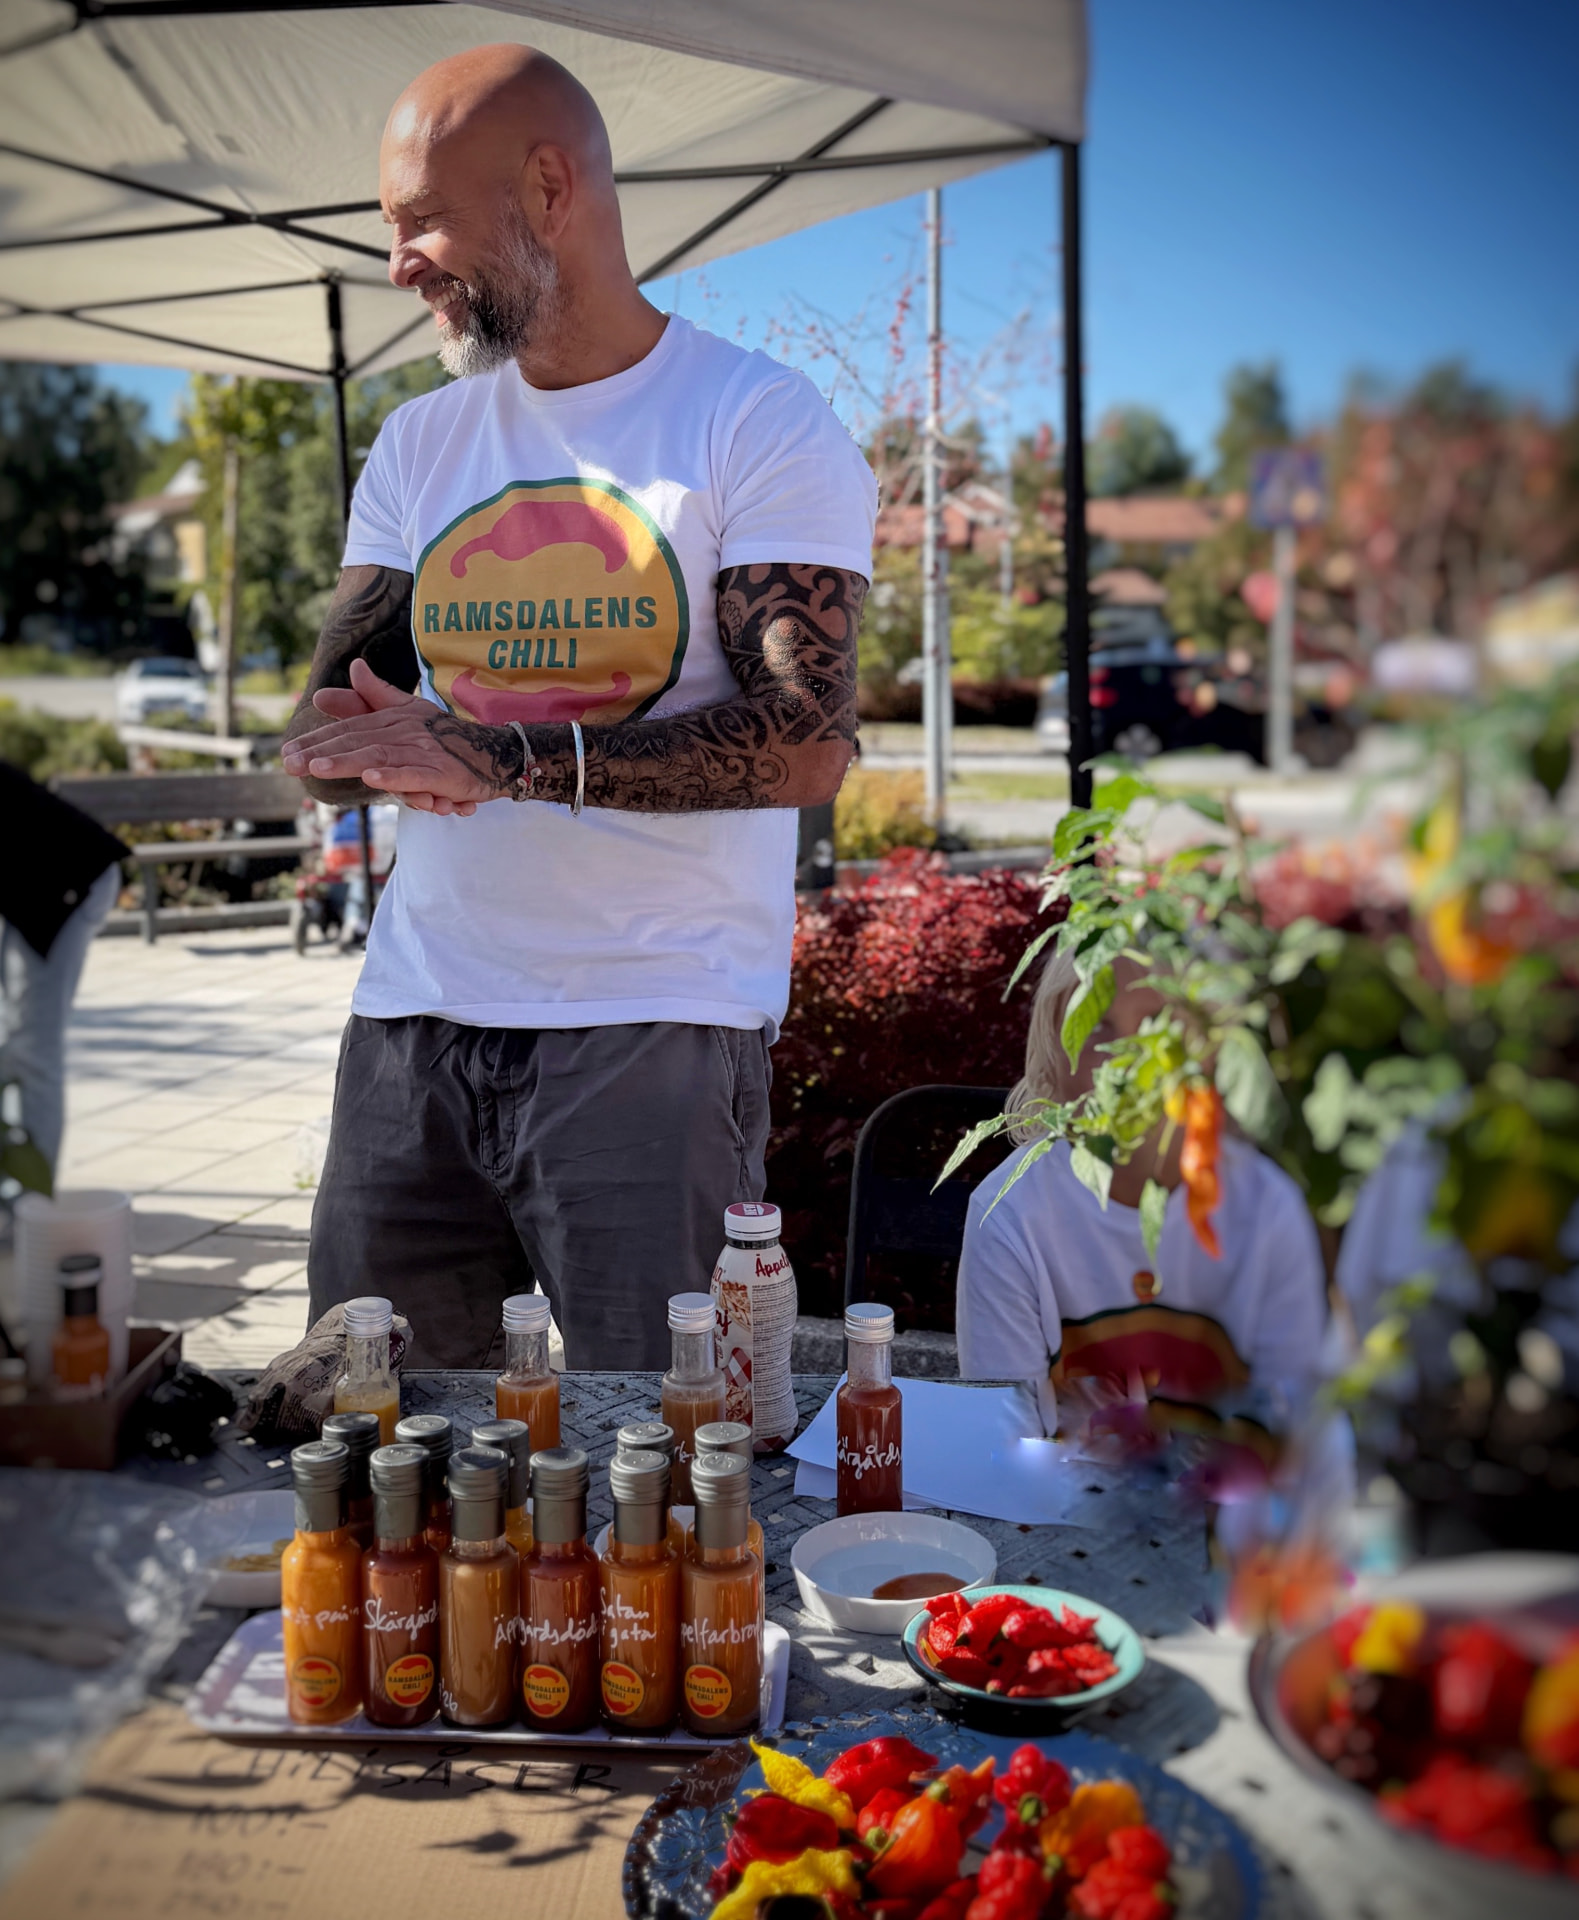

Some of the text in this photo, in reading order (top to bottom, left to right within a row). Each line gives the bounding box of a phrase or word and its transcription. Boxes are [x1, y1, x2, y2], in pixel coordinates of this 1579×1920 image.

[424, 596, 657, 633] RAMSDALENS
[488, 638, 577, 669] CHILI
[602, 1586, 649, 1619] Satan
